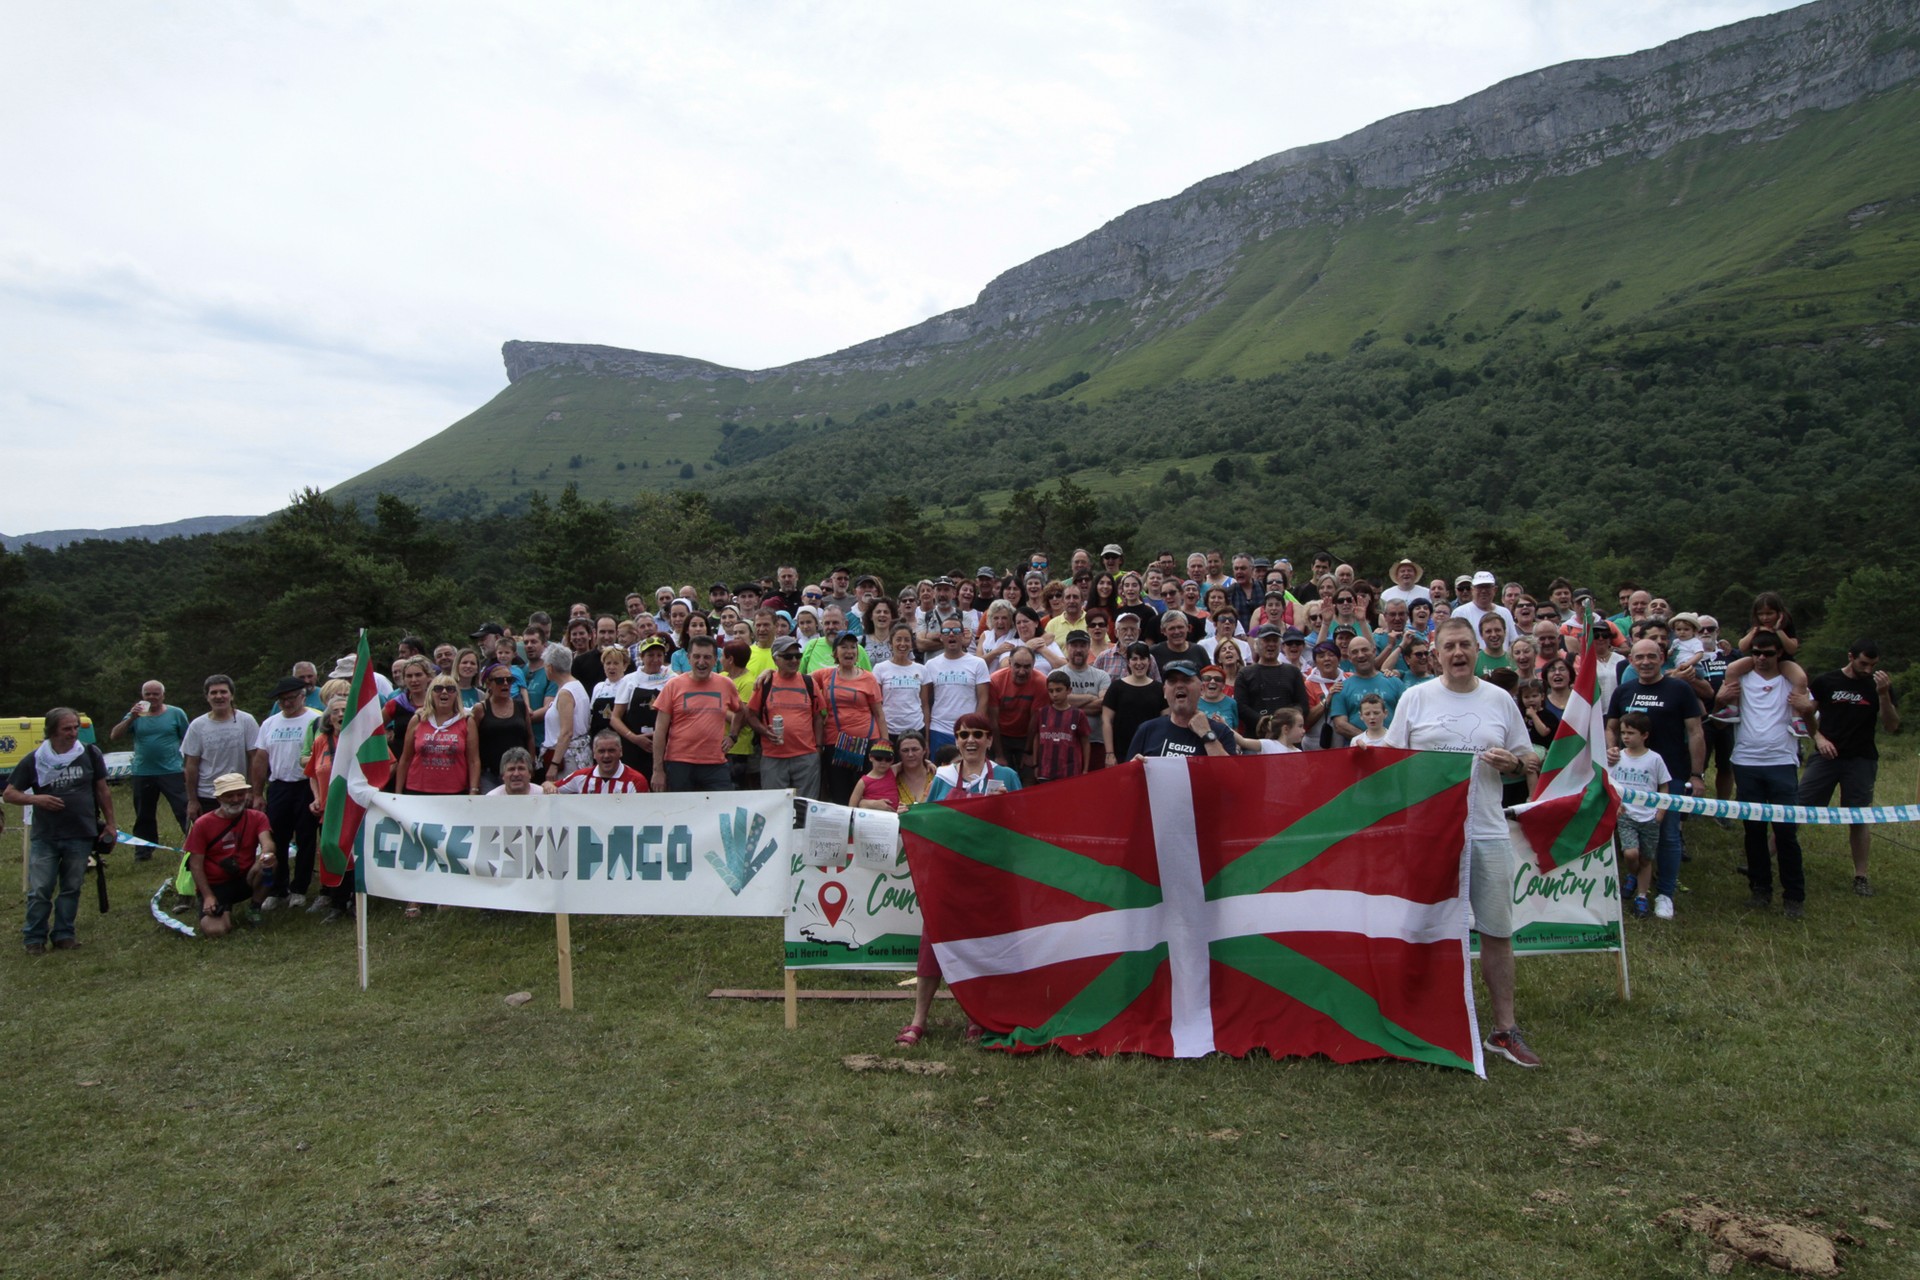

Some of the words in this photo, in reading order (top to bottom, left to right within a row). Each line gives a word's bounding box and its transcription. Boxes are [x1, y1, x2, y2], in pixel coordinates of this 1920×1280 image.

[1634, 700, 1665, 708] POSIBLE
[1168, 742, 1196, 753] EGIZU
[1513, 862, 1597, 908] Country
[1516, 934, 1538, 944] Gure
[1540, 933, 1579, 945] helmuga
[801, 947, 828, 958] Herria
[867, 946, 889, 956] Gure
